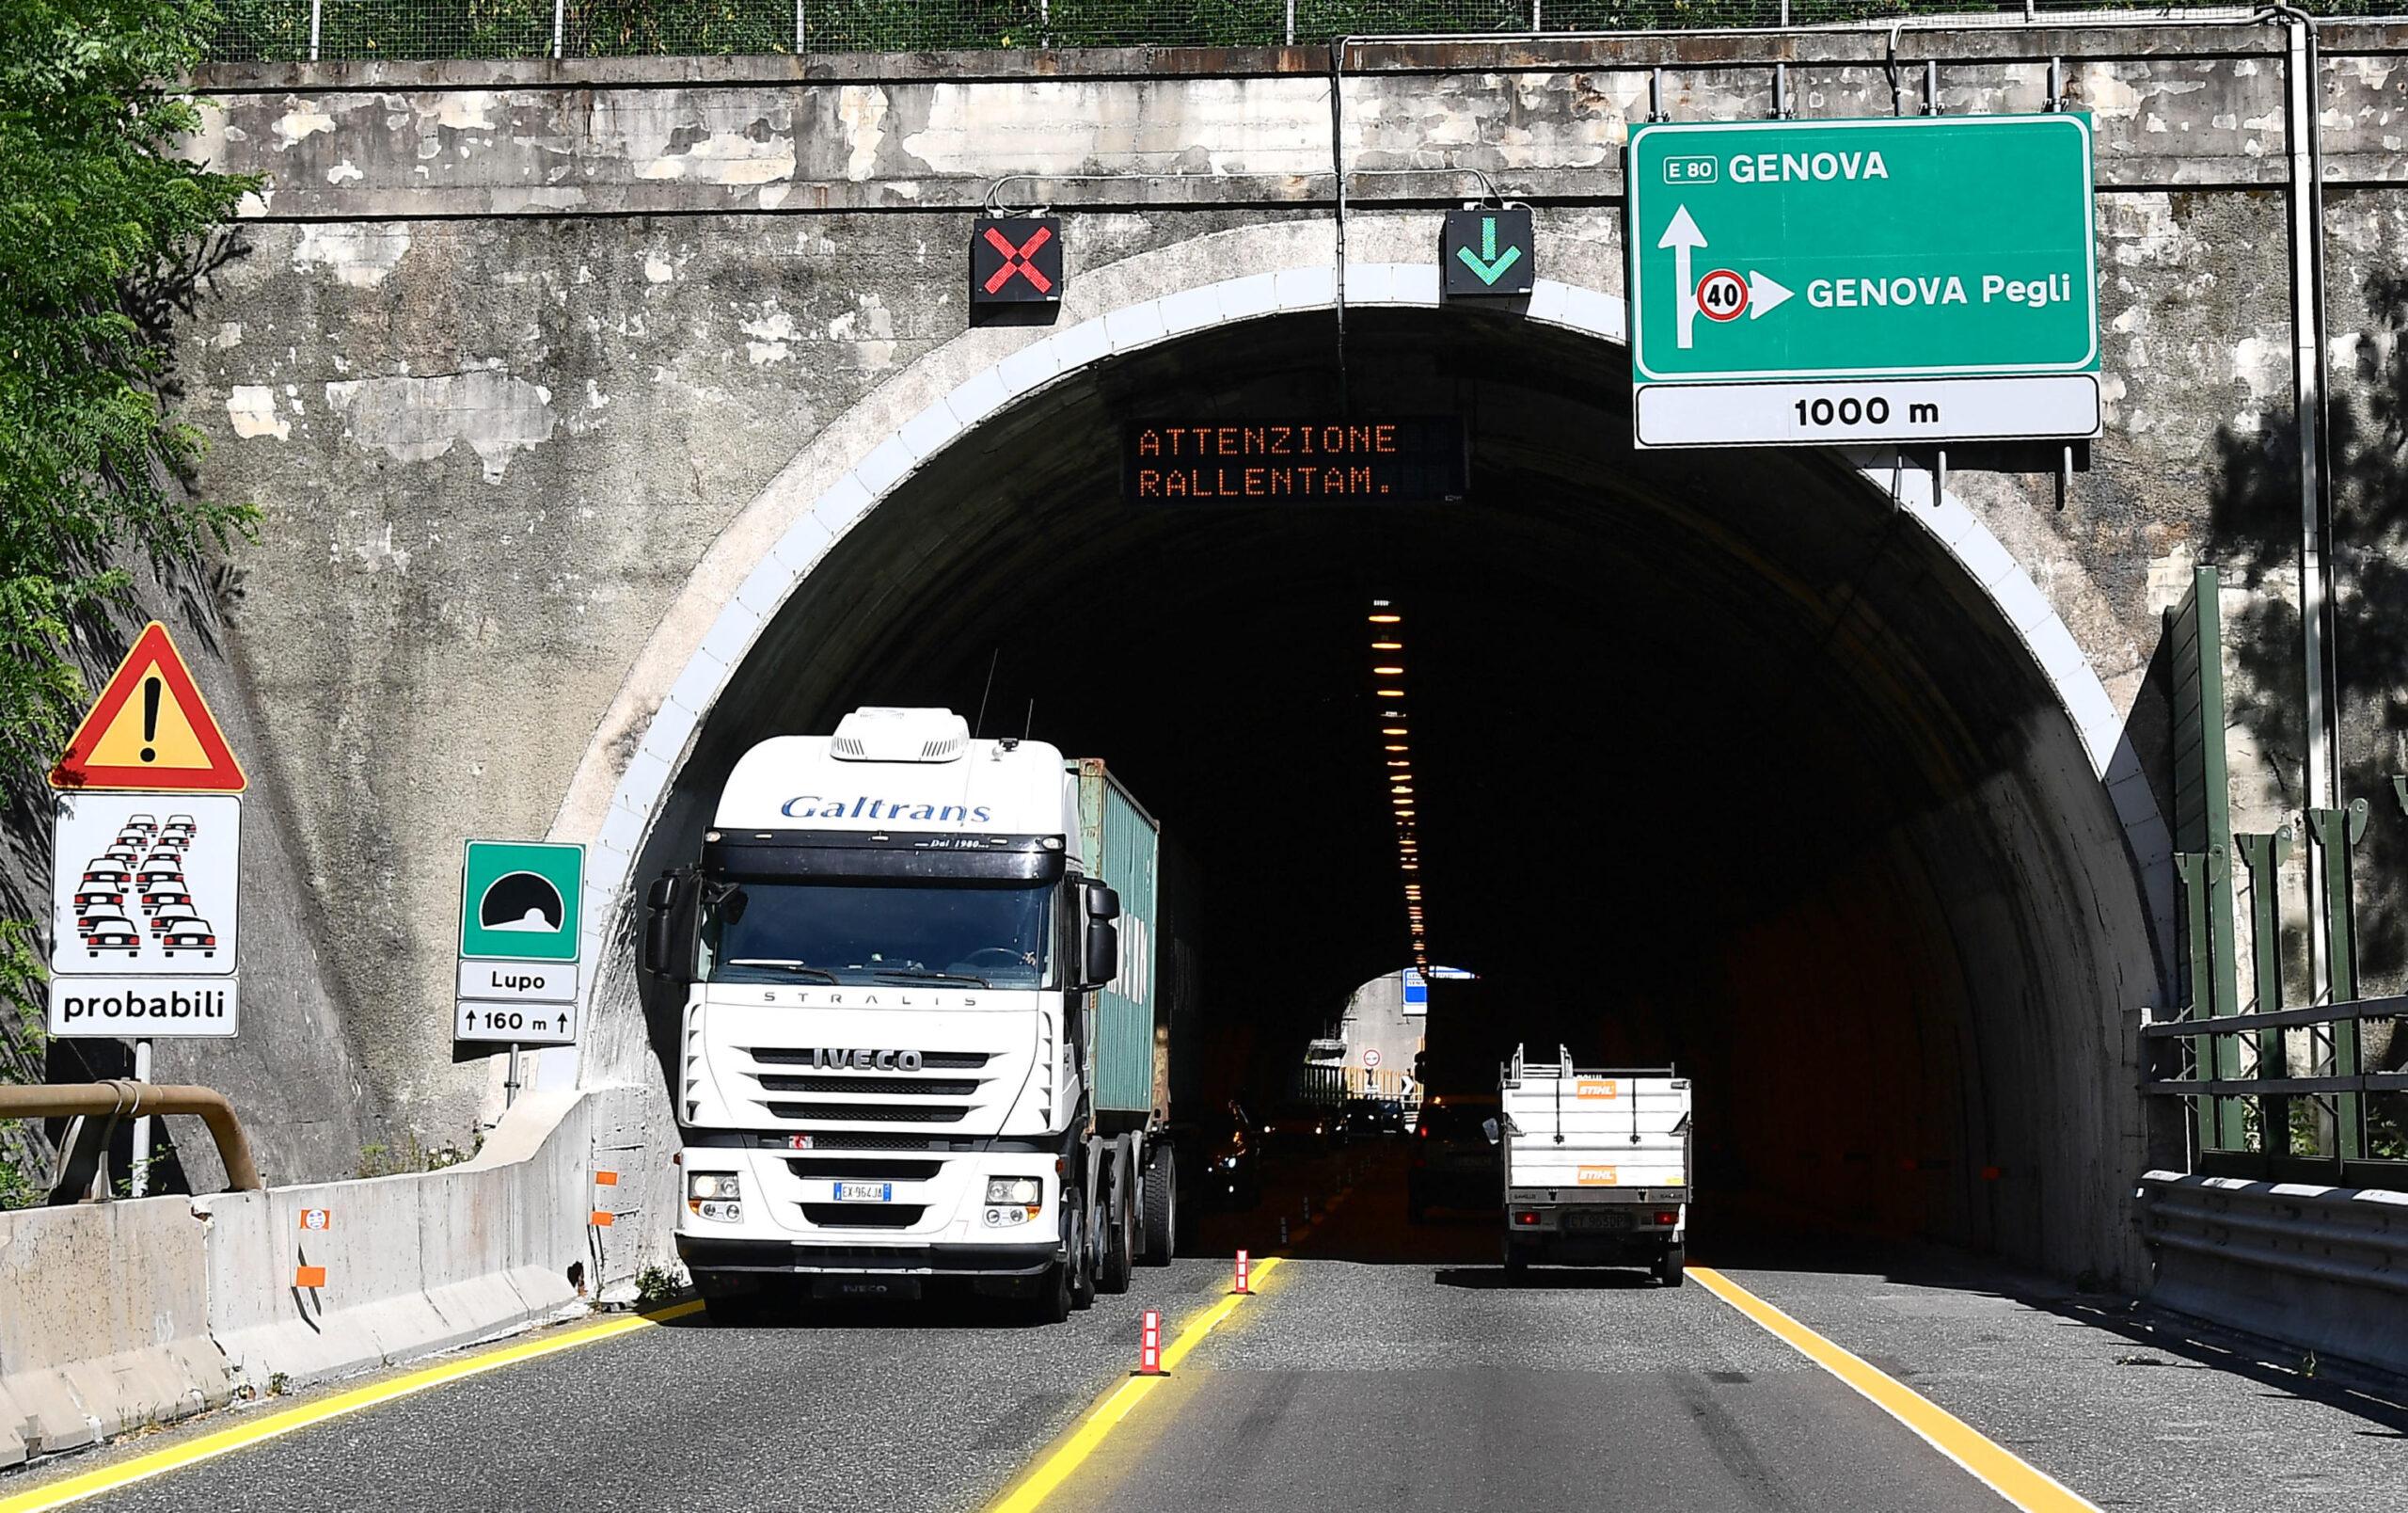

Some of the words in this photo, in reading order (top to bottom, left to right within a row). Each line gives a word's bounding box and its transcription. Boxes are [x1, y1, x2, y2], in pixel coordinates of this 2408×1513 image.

[1669, 163, 1681, 178] E
[1687, 162, 1713, 177] 80
[1729, 151, 1890, 183] GENOVA
[1706, 283, 1738, 307] 40
[1807, 276, 1968, 308] GENOVA
[1982, 273, 2070, 308] Pegli
[1795, 396, 1890, 426] 1000
[1909, 402, 1940, 423] m
[1140, 425, 1396, 456] ATTENZIONE
[1140, 466, 1389, 497] RALLENTAM.
[781, 795, 990, 824] Galtrans
[491, 970, 546, 992] Lupo
[64, 990, 225, 1023] probabili
[764, 992, 976, 1007] STRALIS
[484, 1011, 523, 1029] 160
[531, 1020, 547, 1030] m
[813, 1047, 923, 1072] IVECO
[1578, 1085, 1614, 1095] STIHL
[1579, 1170, 1614, 1180] STIHL
